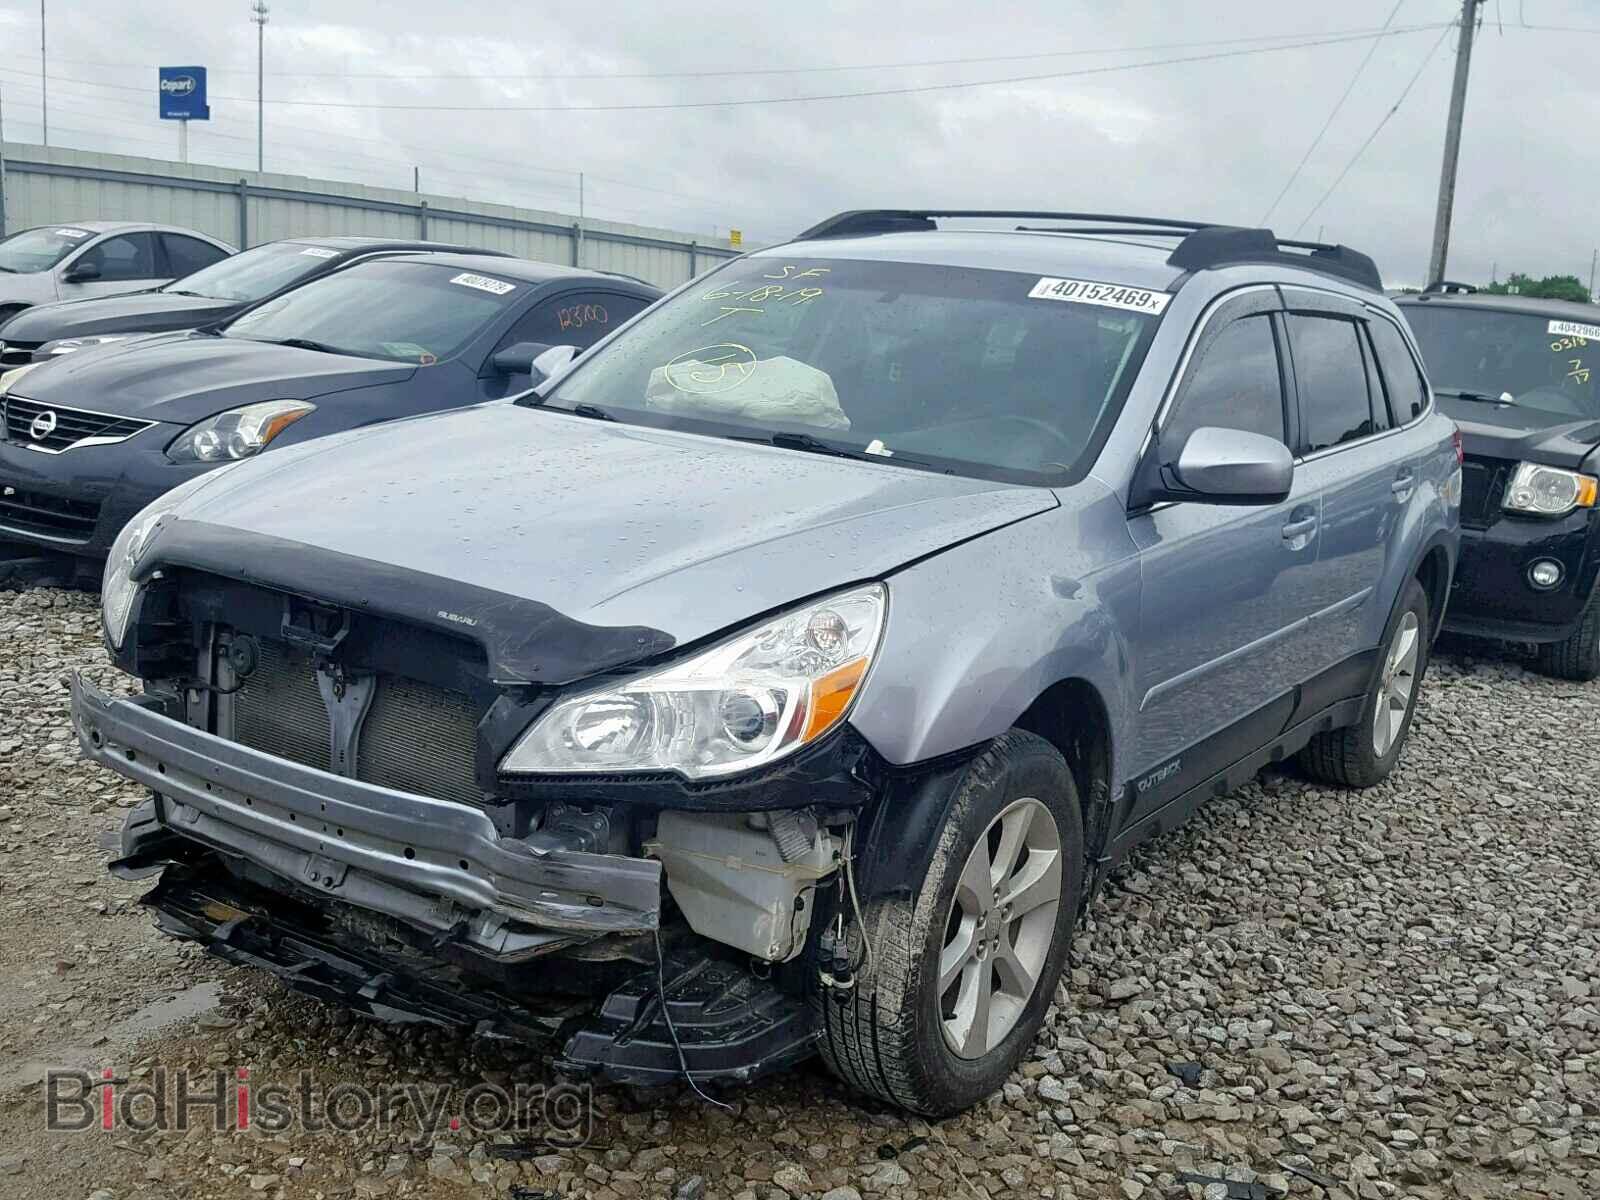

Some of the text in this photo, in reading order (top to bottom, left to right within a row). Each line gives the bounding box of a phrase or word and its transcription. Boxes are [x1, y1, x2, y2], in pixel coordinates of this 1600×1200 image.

[160, 79, 193, 93] Copart
[436, 610, 478, 626] SUBARU
[1137, 759, 1182, 792] OUTBACK
